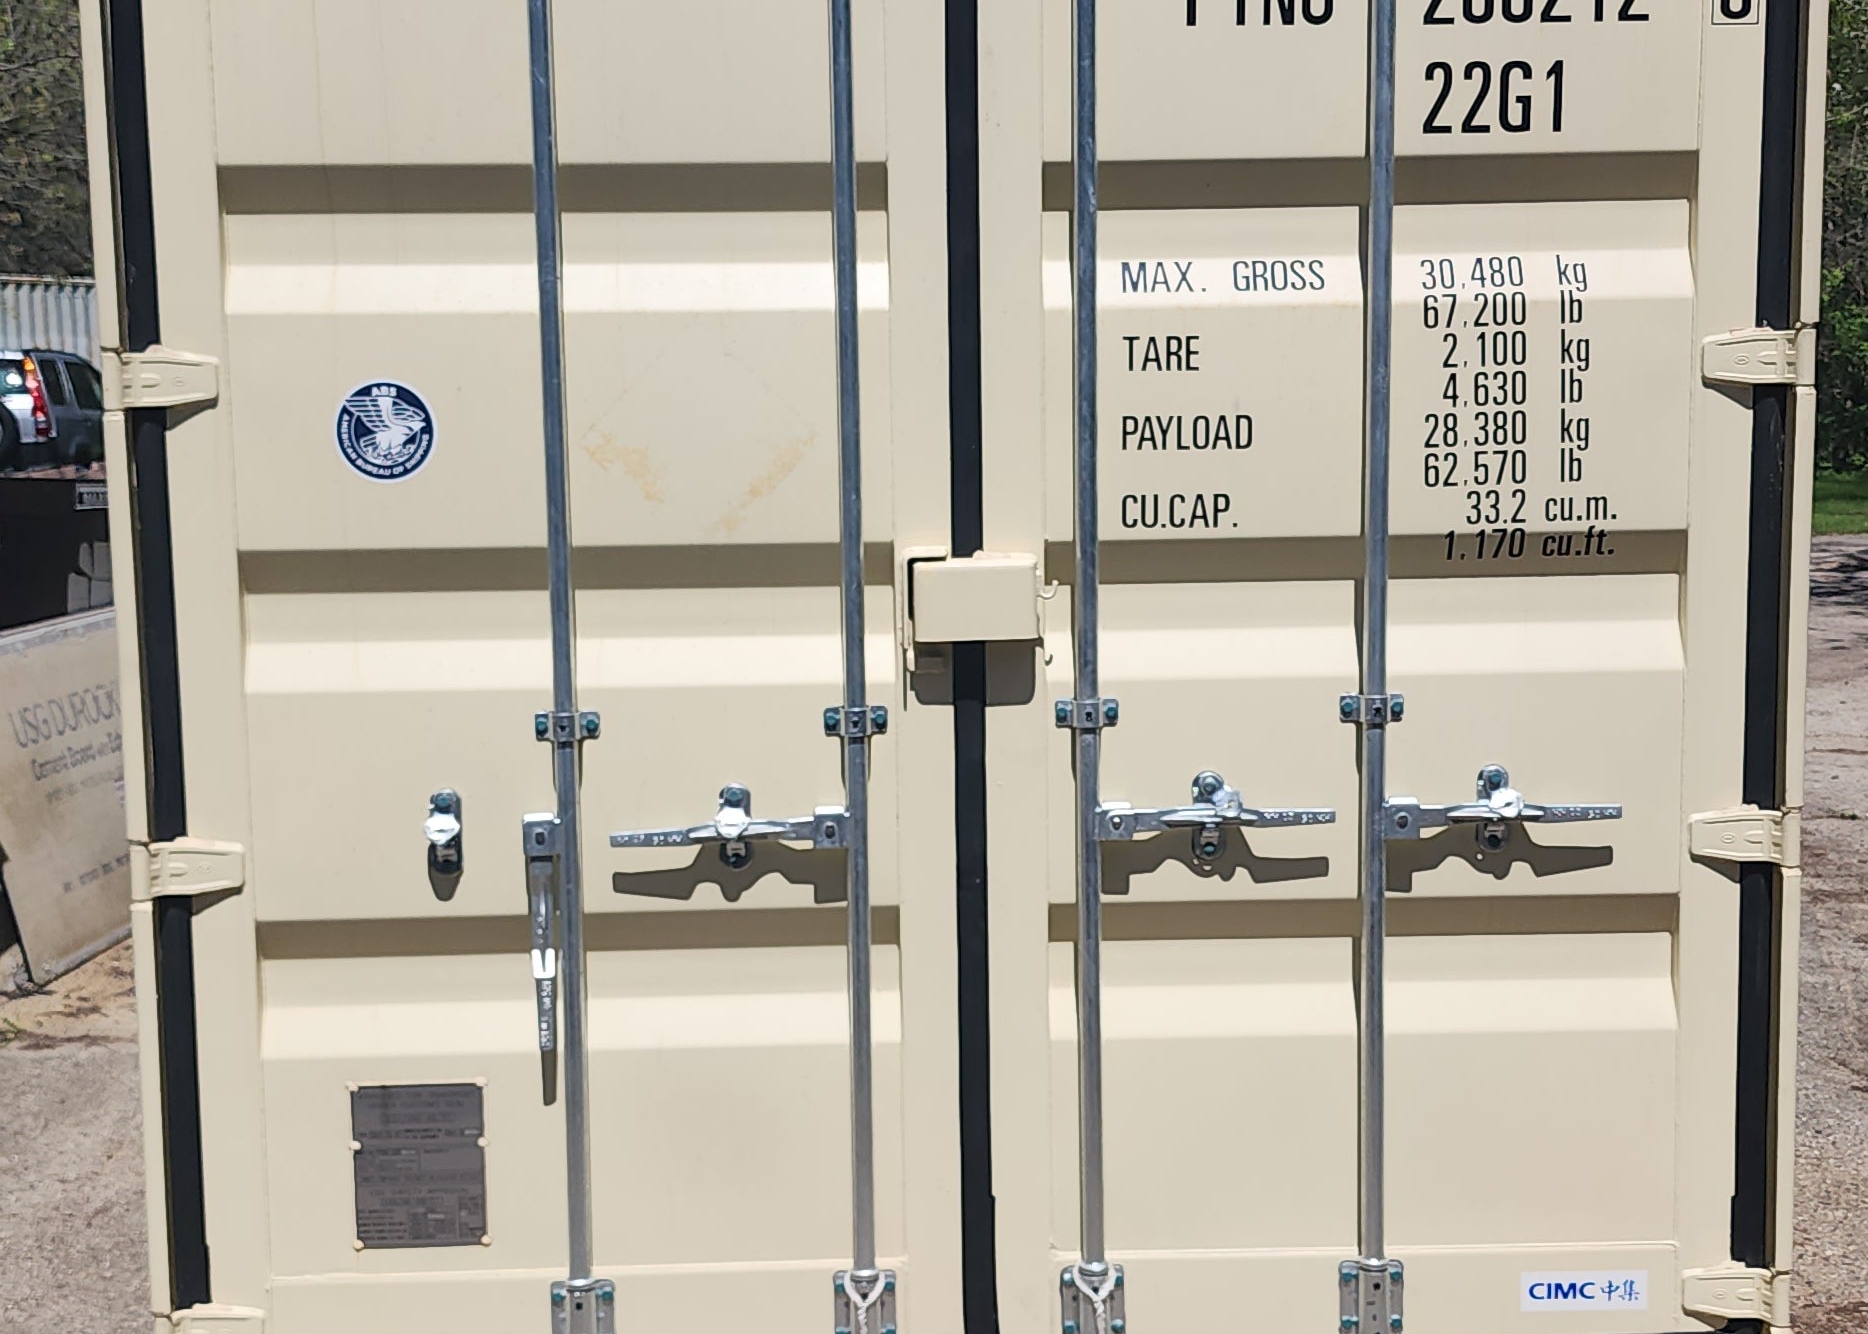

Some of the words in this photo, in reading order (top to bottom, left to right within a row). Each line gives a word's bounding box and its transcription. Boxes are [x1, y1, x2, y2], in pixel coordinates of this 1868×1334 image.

[1422, 59, 1565, 135] 22G1
[1120, 261, 1207, 294] MAX.
[1232, 259, 1327, 292] GROSS
[1420, 255, 1524, 290] 30,480
[1556, 254, 1588, 293] kg
[1423, 291, 1527, 329] 67,200
[1560, 289, 1583, 324] lb
[1122, 335, 1200, 372] TARE
[1442, 330, 1527, 369] 2,100
[1560, 328, 1590, 372] kg
[371, 386, 397, 397] ABS
[1442, 370, 1527, 408] 4,630
[1560, 368, 1583, 404] lb
[1121, 414, 1254, 451] PAYLOAD
[1424, 410, 1527, 448] 28,380
[1560, 408, 1590, 451] kg
[1424, 449, 1527, 487] 62,570
[1560, 447, 1583, 483] lb
[1121, 493, 1239, 529] CU.CAP.
[1465, 489, 1527, 525] 33.2
[1544, 495, 1618, 522] cu.m.
[1541, 525, 1615, 557] cu.ft.
[1528, 1282, 1596, 1300] CIMC
